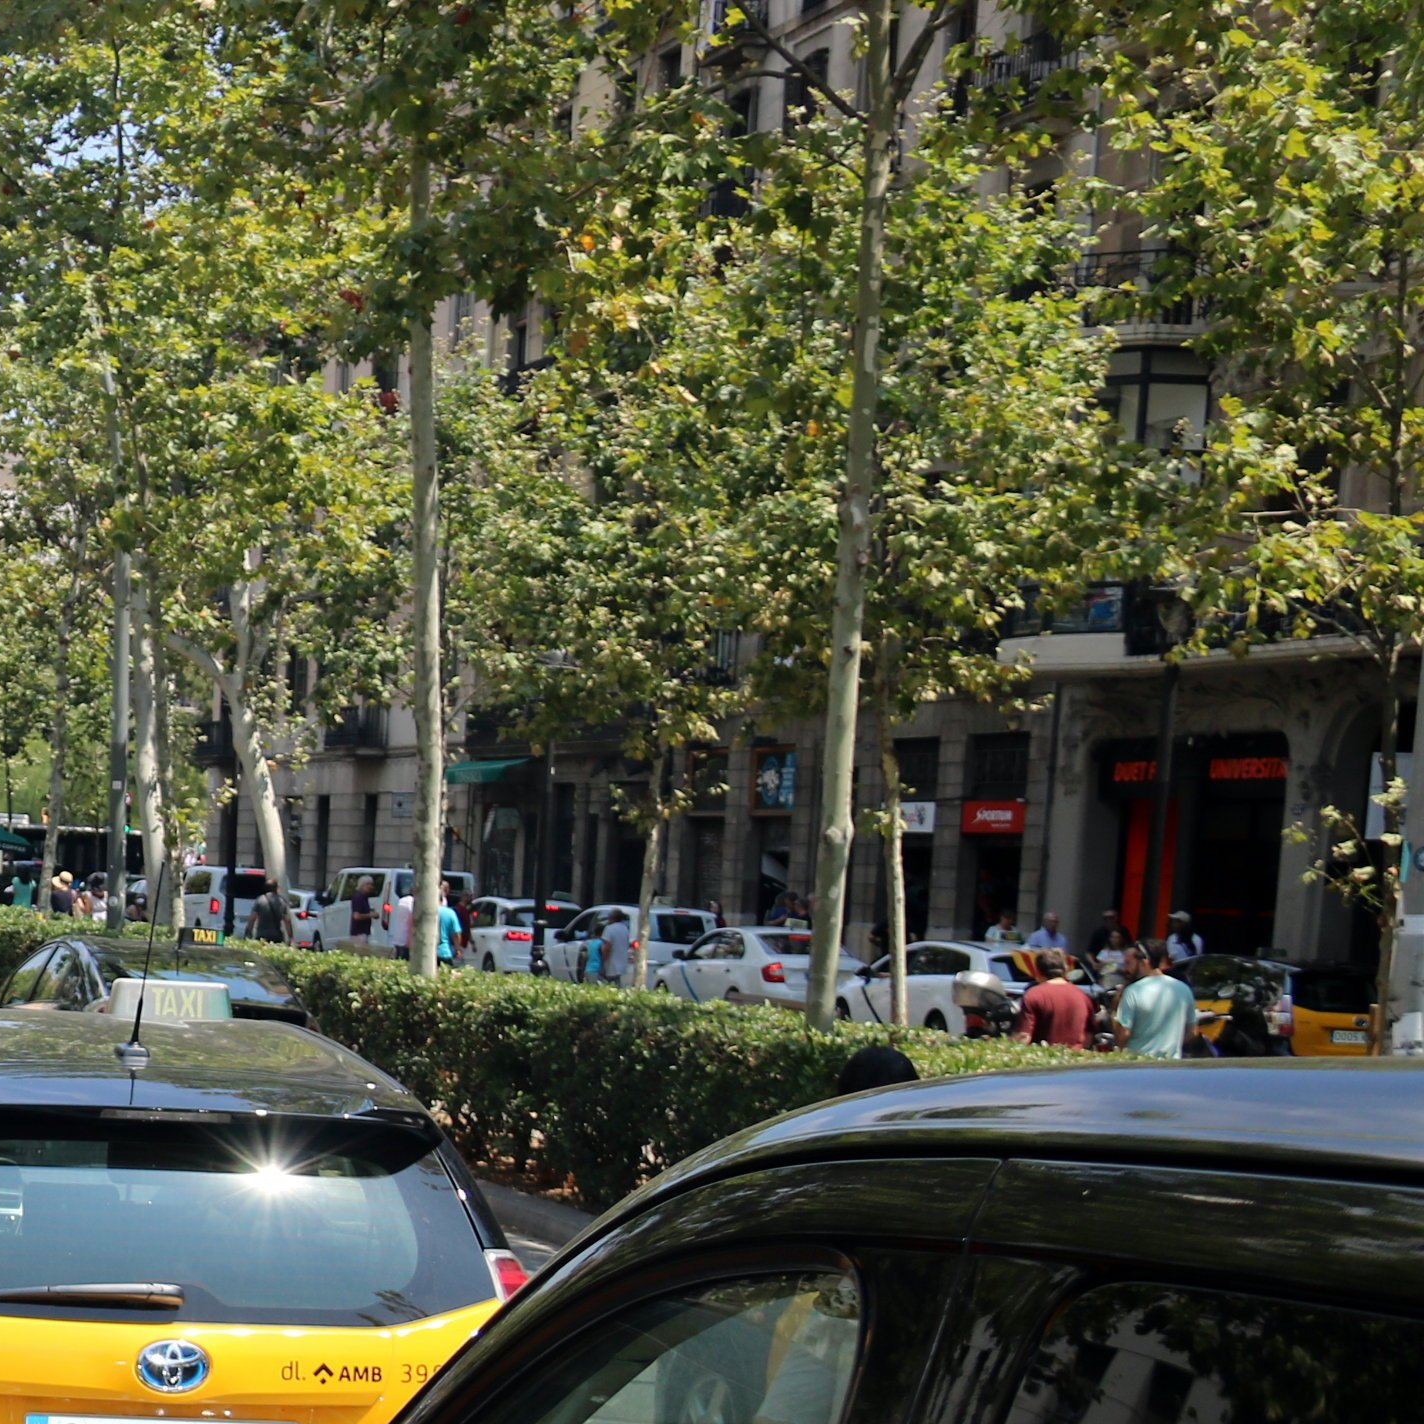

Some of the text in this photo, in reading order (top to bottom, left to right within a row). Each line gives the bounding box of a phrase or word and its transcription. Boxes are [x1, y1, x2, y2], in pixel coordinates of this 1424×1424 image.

[192, 929, 218, 943] TAXI
[151, 988, 203, 1018] TAXI
[338, 1366, 383, 1383] AMB
[400, 1363, 442, 1383] 39
